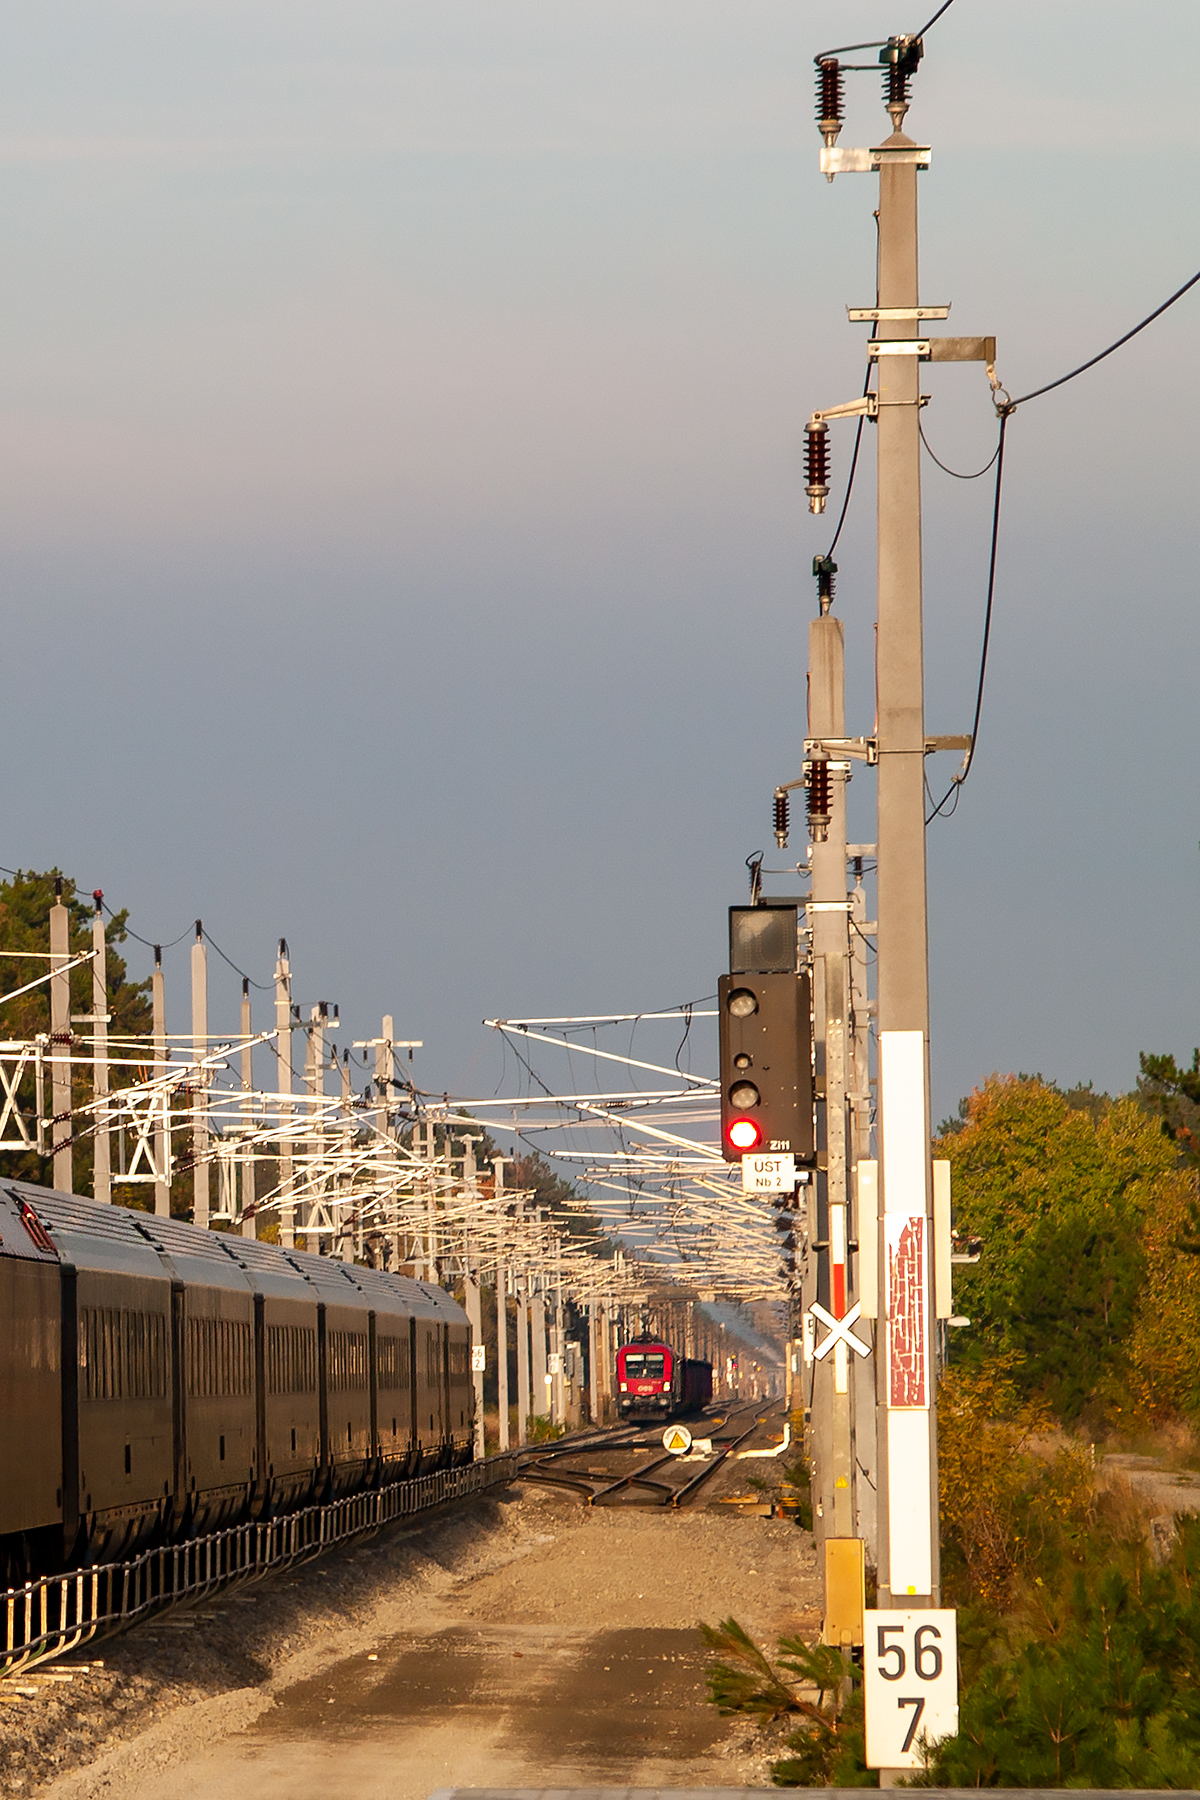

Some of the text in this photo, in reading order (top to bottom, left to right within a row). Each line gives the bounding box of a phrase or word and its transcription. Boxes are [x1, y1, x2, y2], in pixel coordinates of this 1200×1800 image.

[754, 1159, 782, 1172] ÜST
[756, 1177, 782, 1187] Nb 2
[877, 1624, 943, 1681] 56
[897, 1697, 926, 1753] 7
